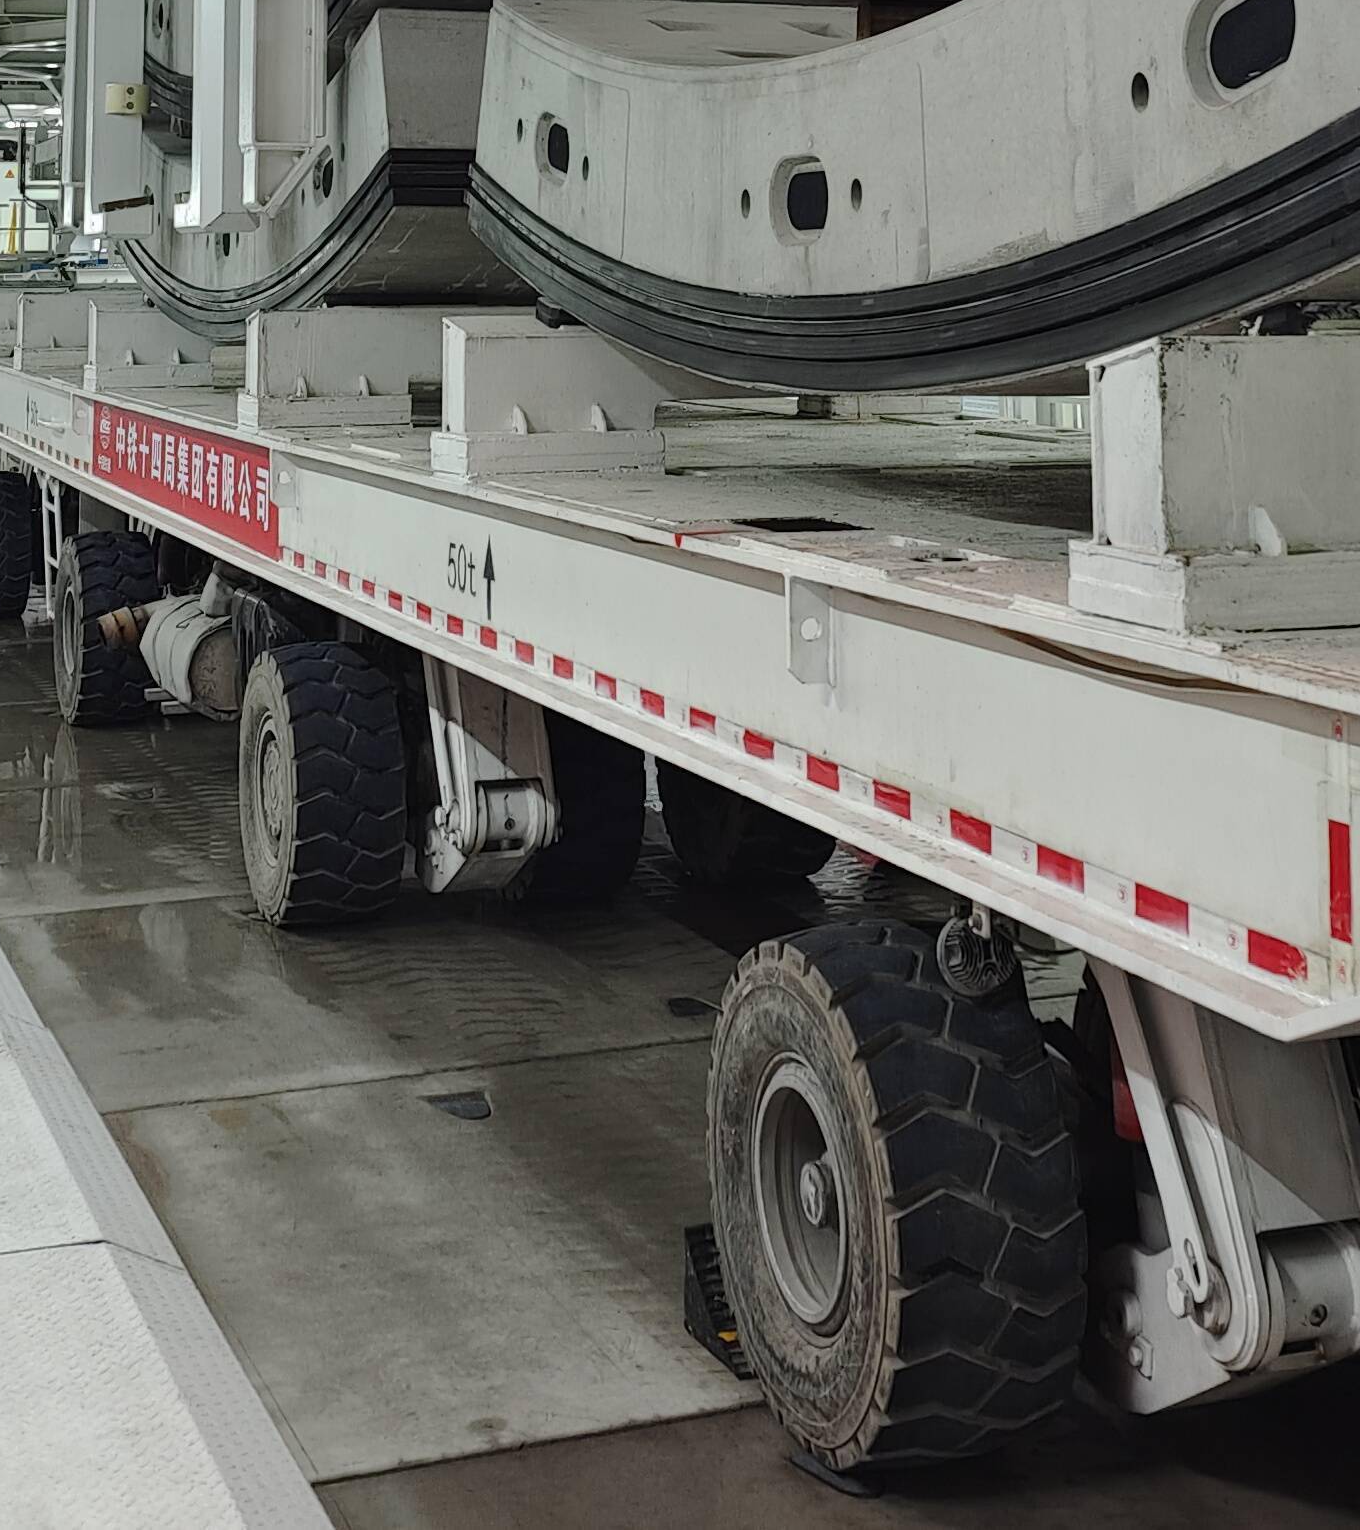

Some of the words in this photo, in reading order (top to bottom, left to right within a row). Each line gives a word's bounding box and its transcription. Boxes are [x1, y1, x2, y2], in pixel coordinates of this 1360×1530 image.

[115, 416, 269, 532] 中铁十四局集团有限公司
[447, 542, 476, 597] 50t
